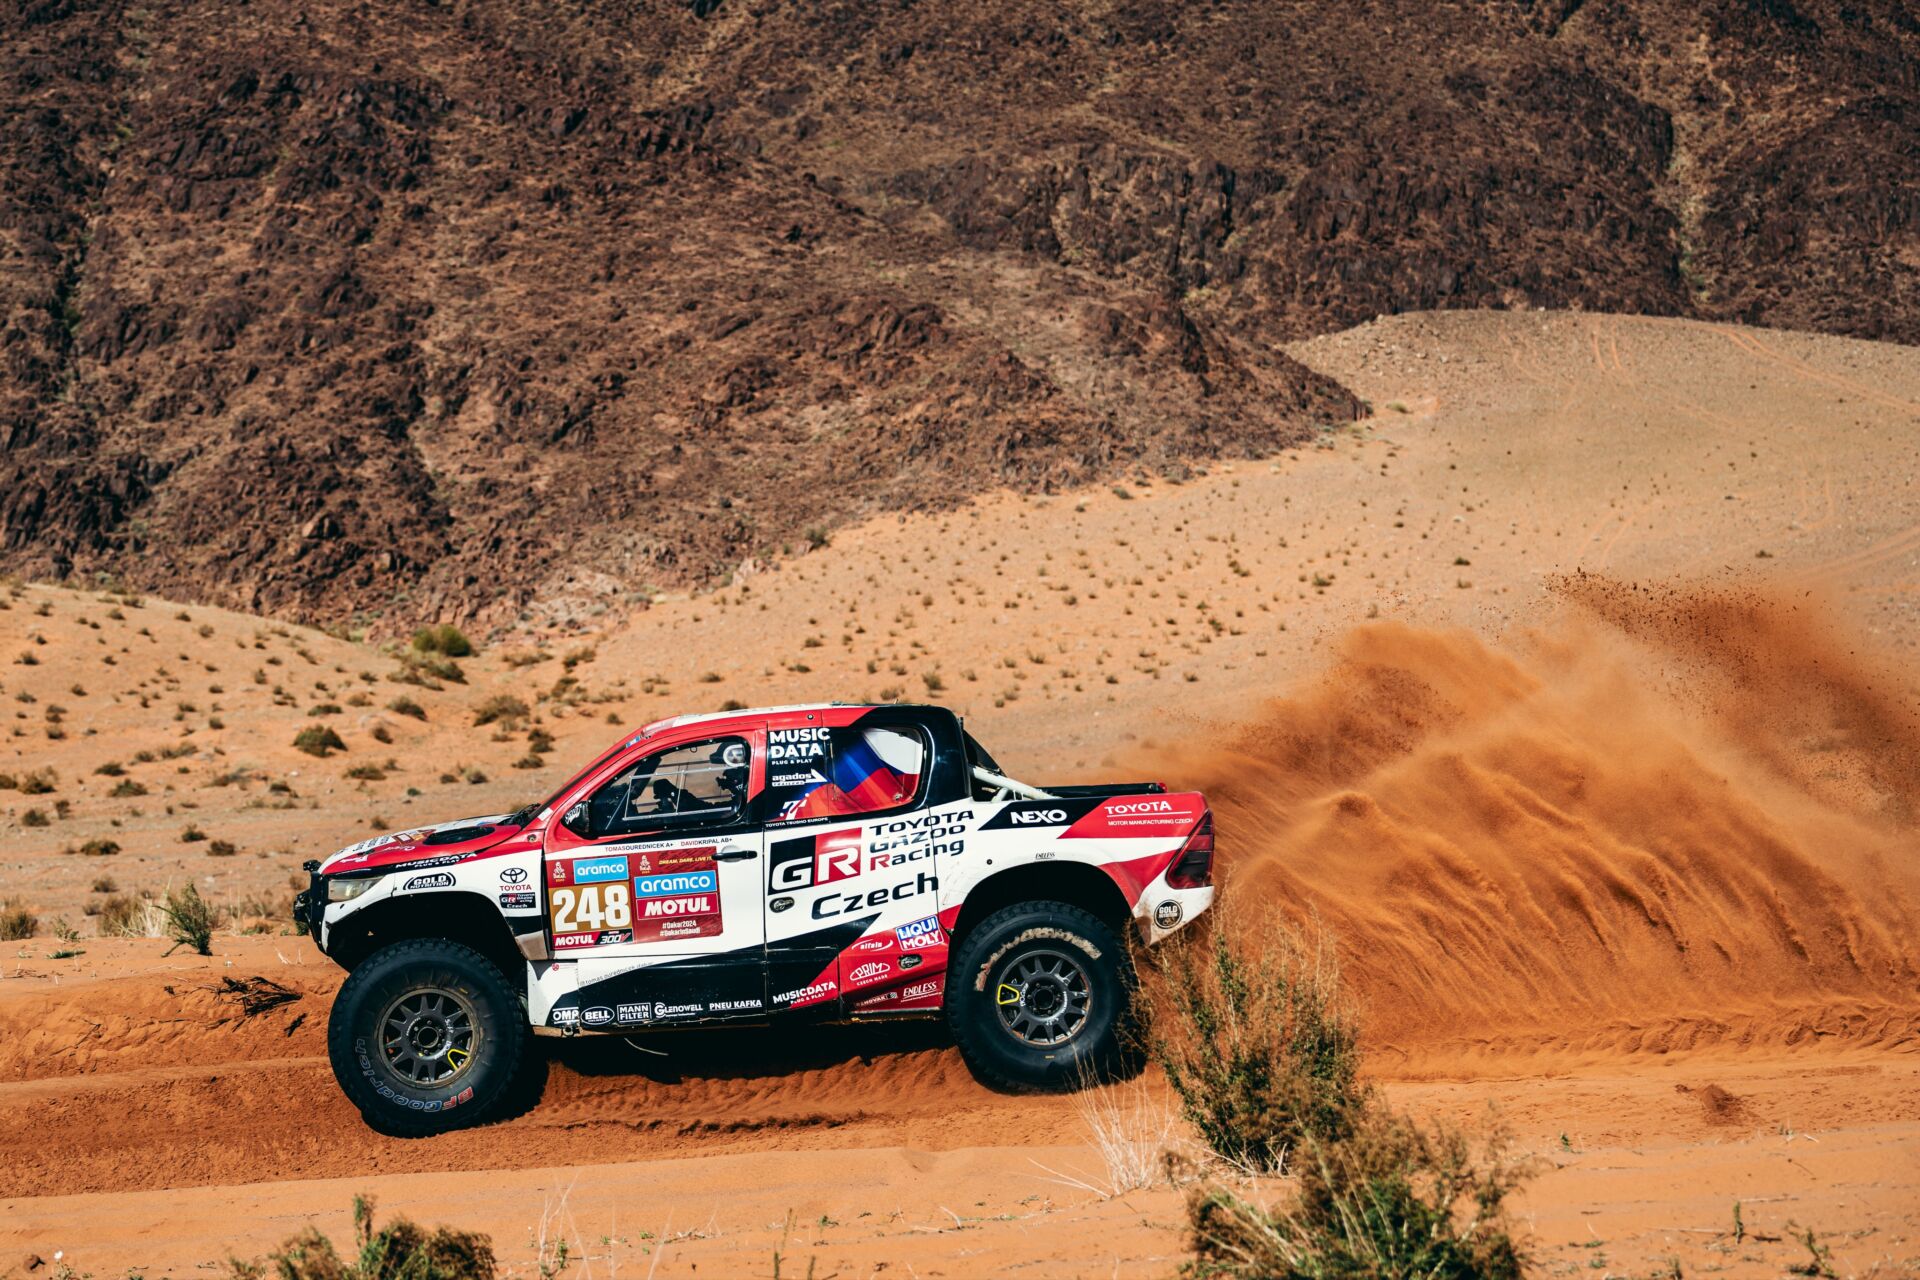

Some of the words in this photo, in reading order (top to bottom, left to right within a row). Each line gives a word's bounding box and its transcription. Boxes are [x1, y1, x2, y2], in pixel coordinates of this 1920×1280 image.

[769, 727, 831, 744] MUSIC
[770, 743, 824, 759] DATA
[772, 772, 812, 782] agados
[1104, 800, 1172, 815] TOYOTA
[869, 810, 975, 836] TOYOTA
[1010, 809, 1068, 824] NEXO
[680, 838, 720, 847] DAVIDKRIPAL
[869, 825, 966, 854] GAZOO
[395, 853, 477, 868] MUSICDATA
[869, 840, 965, 872] Racing
[577, 864, 625, 876] aramco
[771, 847, 860, 891] GR
[410, 881, 449, 889] NUTRITION
[413, 875, 447, 885] GOLD
[641, 875, 711, 892] aramco
[811, 872, 939, 920] Czech
[552, 884, 631, 932] 248
[644, 897, 711, 917] MOTUL
[1159, 905, 1178, 914] GOLD
[662, 920, 697, 929] #Dakar2024
[898, 917, 938, 940] LIQUI
[555, 935, 595, 947] MOTUL
[600, 932, 631, 944] 300V
[901, 930, 941, 950] MOLY
[855, 962, 884, 978] PRIM
[856, 977, 873, 986] CZECH
[772, 981, 837, 1004] MUSICDATA
[903, 981, 938, 998] ENDLESS
[709, 1001, 732, 1011] PNEU
[733, 999, 763, 1008] KAFKA
[790, 996, 805, 1004] PLUG
[811, 992, 825, 1000] PLAY
[553, 1009, 580, 1021] OMP
[584, 1010, 610, 1020] BELL
[620, 1004, 649, 1013] MANN
[620, 1011, 650, 1020] FILTER
[355, 1037, 474, 1112] BFGoodrich
